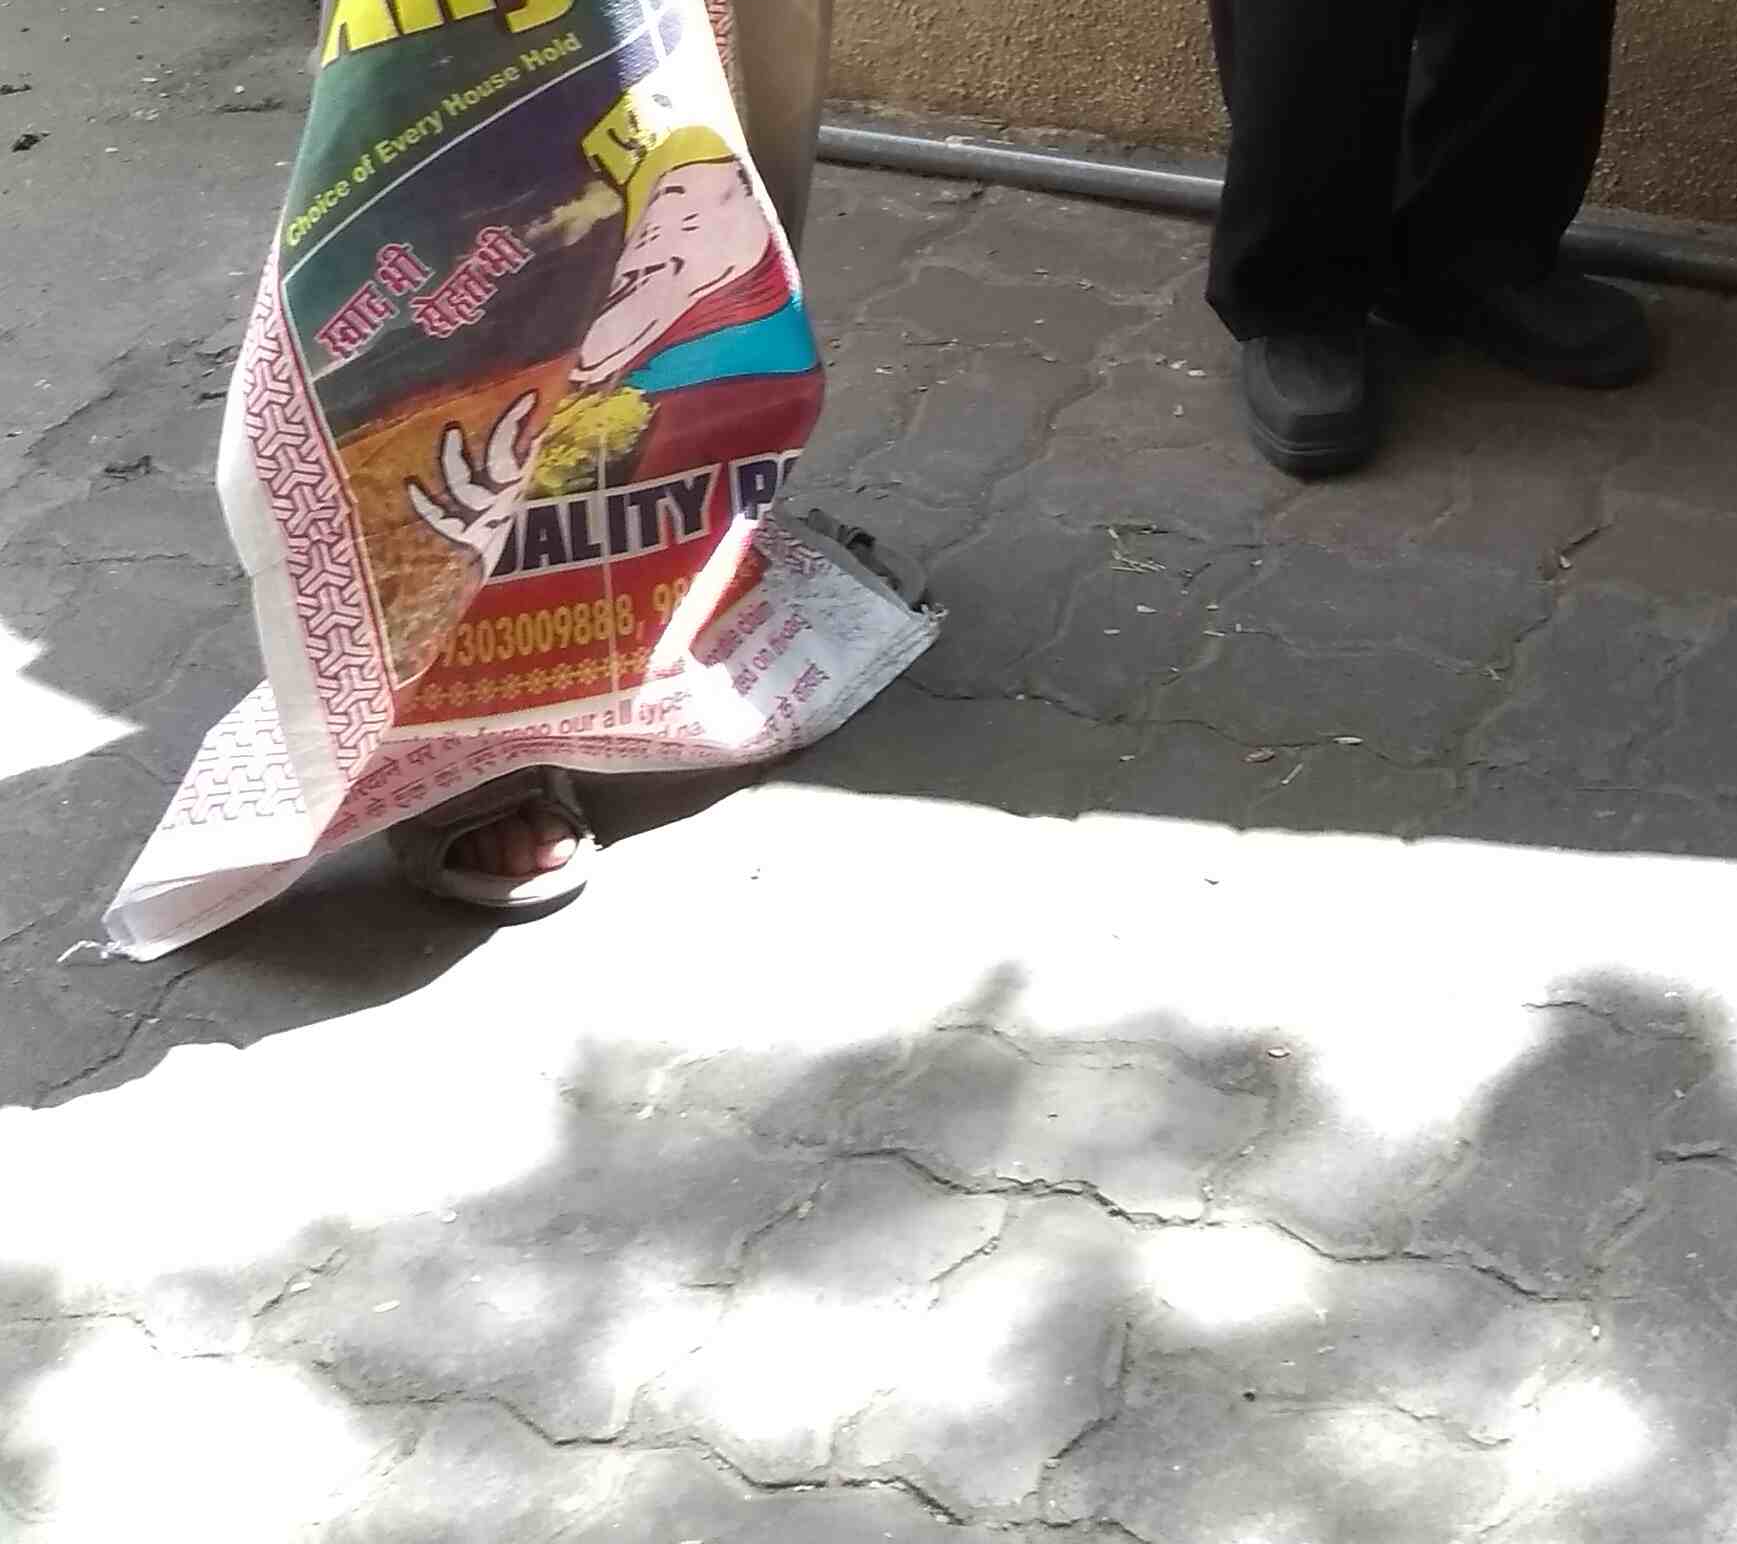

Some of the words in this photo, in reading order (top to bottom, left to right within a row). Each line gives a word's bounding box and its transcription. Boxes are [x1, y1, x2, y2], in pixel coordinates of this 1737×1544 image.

[284, 184, 352, 250] Choice
[350, 151, 377, 188] of
[374, 105, 446, 168] Every
[446, 59, 523, 120] House
[520, 30, 585, 76] Hold
[375, 242, 437, 297] भी
[476, 224, 537, 278] भी
